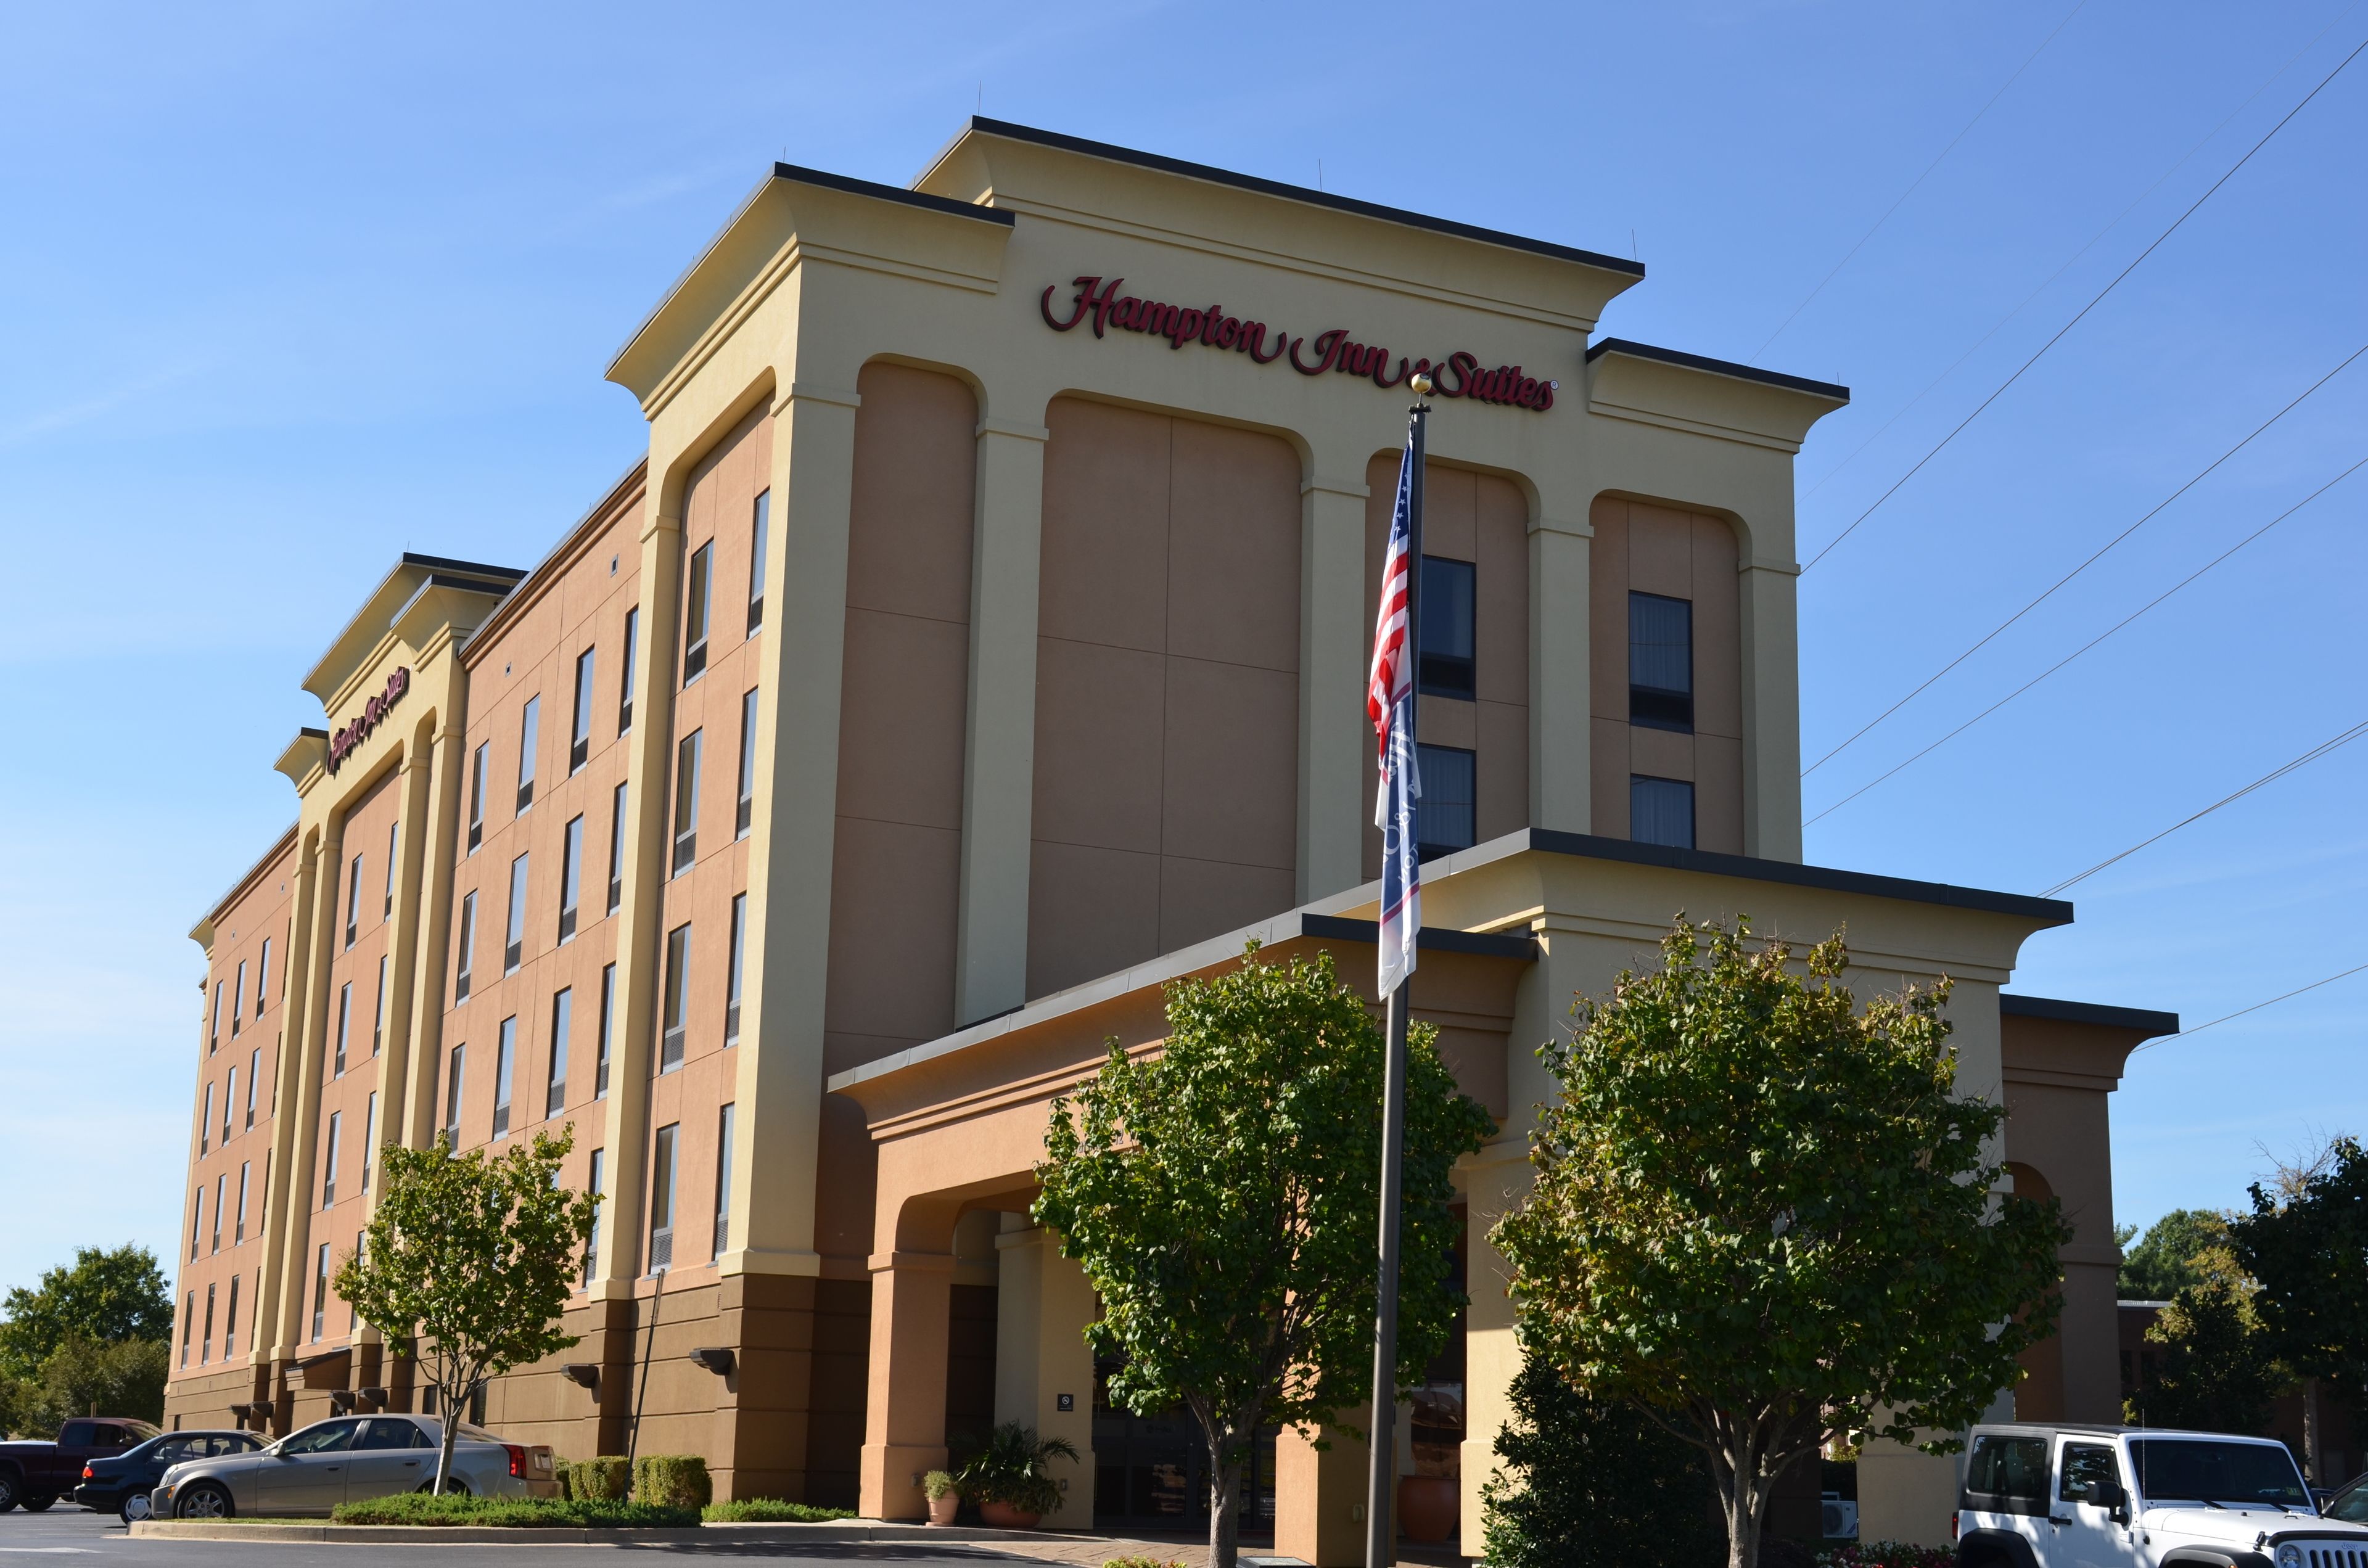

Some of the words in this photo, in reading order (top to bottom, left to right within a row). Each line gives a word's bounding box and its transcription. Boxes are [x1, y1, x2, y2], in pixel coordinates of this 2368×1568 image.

[1042, 276, 1287, 364] Hampton
[1289, 329, 1409, 388] Inn
[1432, 351, 1553, 411] Suites
